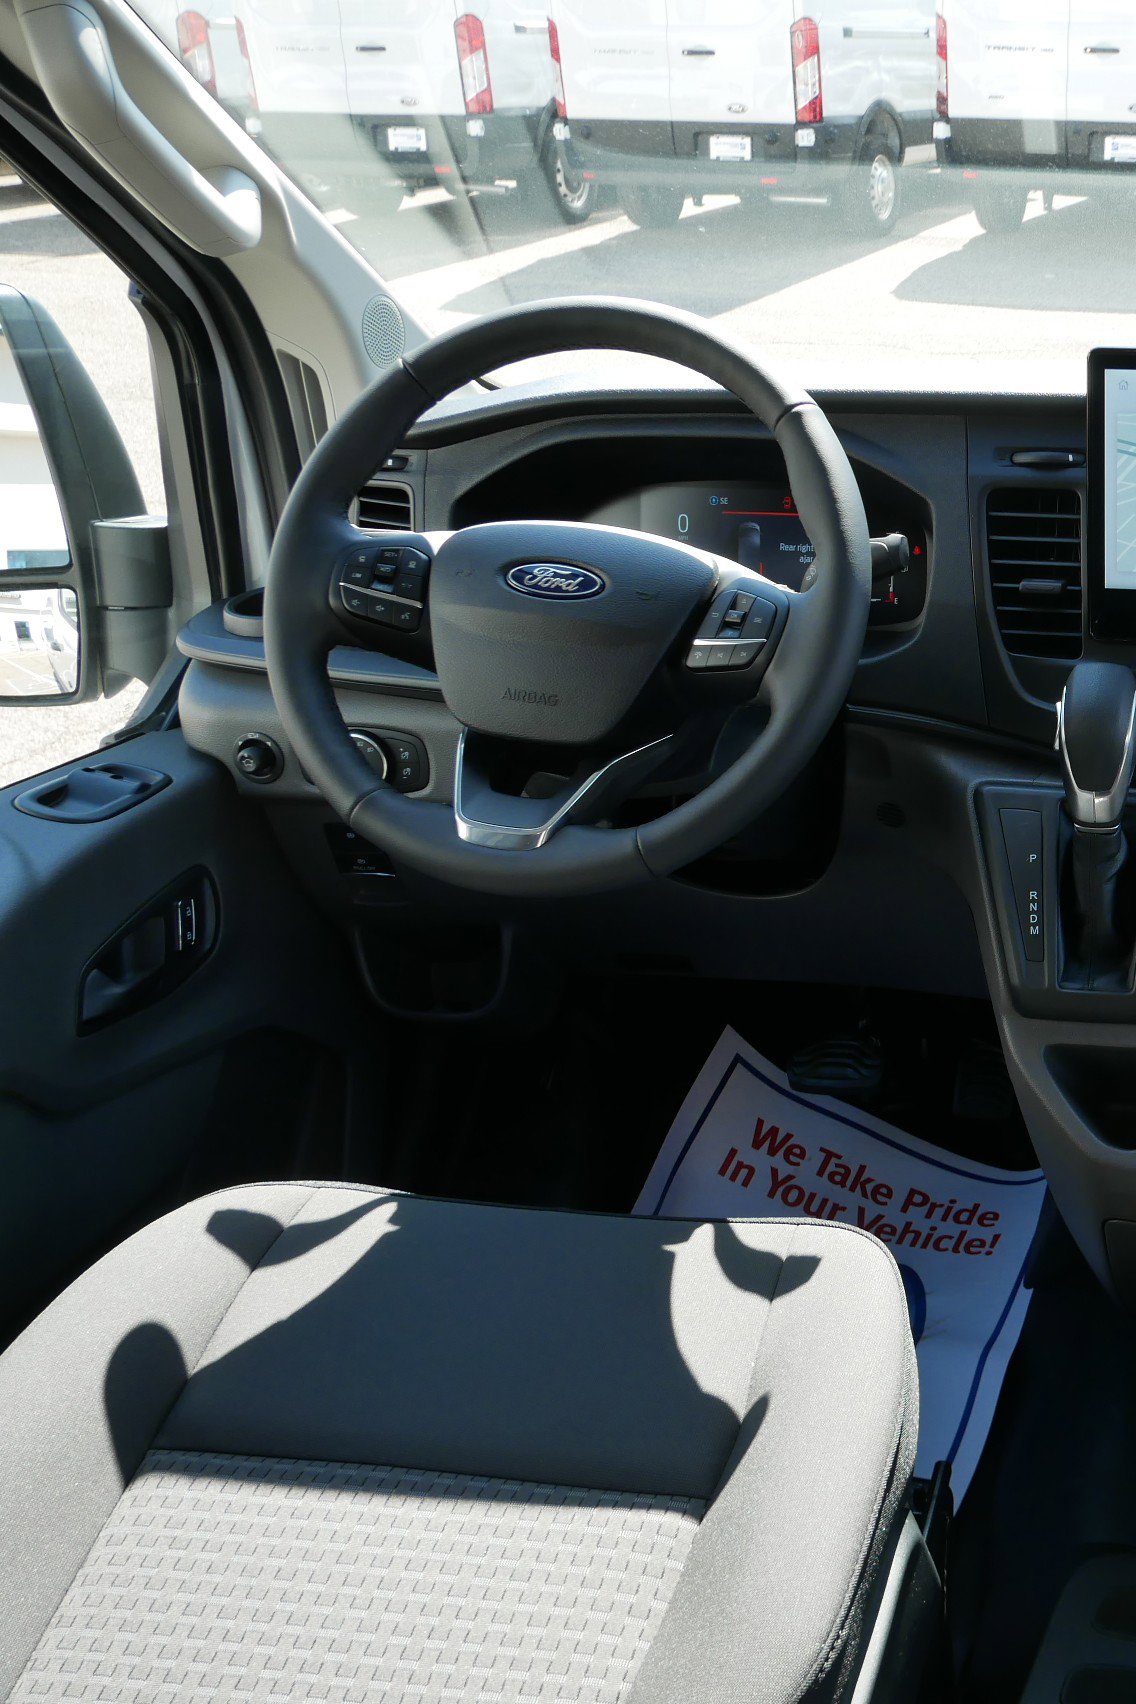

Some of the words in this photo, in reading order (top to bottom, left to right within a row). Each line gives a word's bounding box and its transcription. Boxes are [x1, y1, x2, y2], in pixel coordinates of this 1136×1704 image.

[719, 497, 729, 505] SE
[677, 513, 689, 533] 0
[779, 542, 796, 551] Rear
[797, 543, 814, 554] right
[500, 687, 560, 707] AIRBAG
[1029, 854, 1037, 862] P
[1029, 891, 1038, 899] R
[1029, 903, 1038, 911] N
[1029, 914, 1038, 923] D
[1030, 926, 1039, 935] M
[751, 1117, 807, 1167] We
[815, 1146, 893, 1206] Take
[900, 1187, 1000, 1228] Pride
[717, 1146, 756, 1189] In
[766, 1165, 848, 1220] Your
[856, 1205, 1002, 1256] Vehicle!
